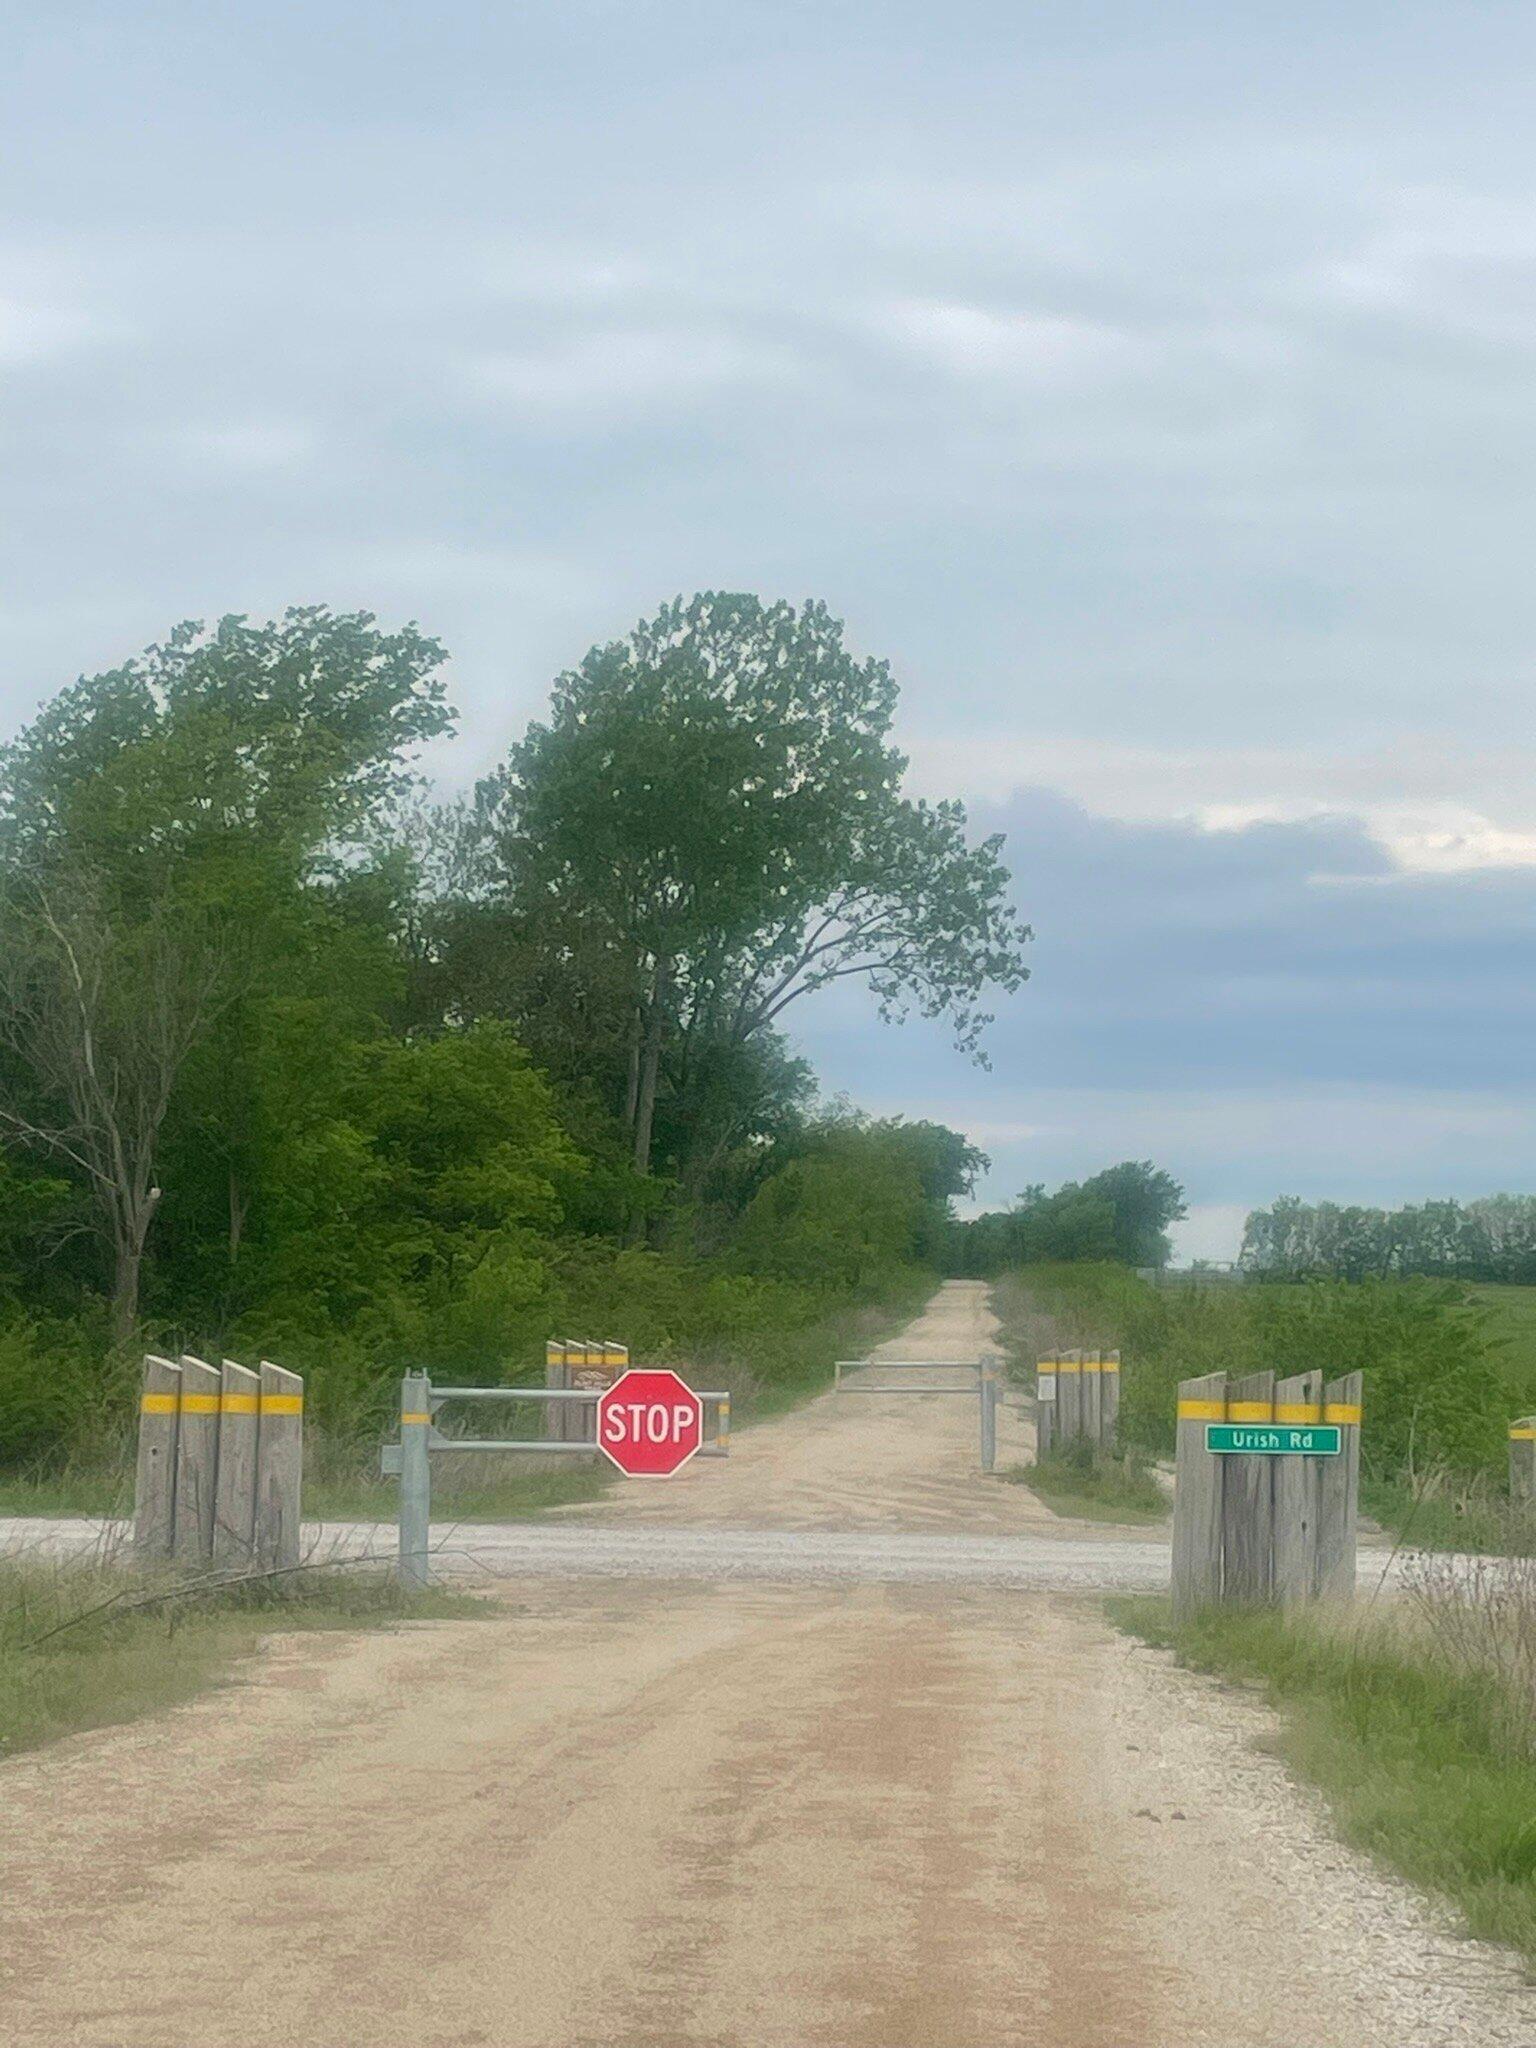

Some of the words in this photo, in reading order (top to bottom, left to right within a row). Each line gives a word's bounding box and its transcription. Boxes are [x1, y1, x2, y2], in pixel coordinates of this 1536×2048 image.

[605, 1403, 694, 1443] STOP
[1232, 1431, 1280, 1448] Urish
[1290, 1431, 1313, 1448] Rd
